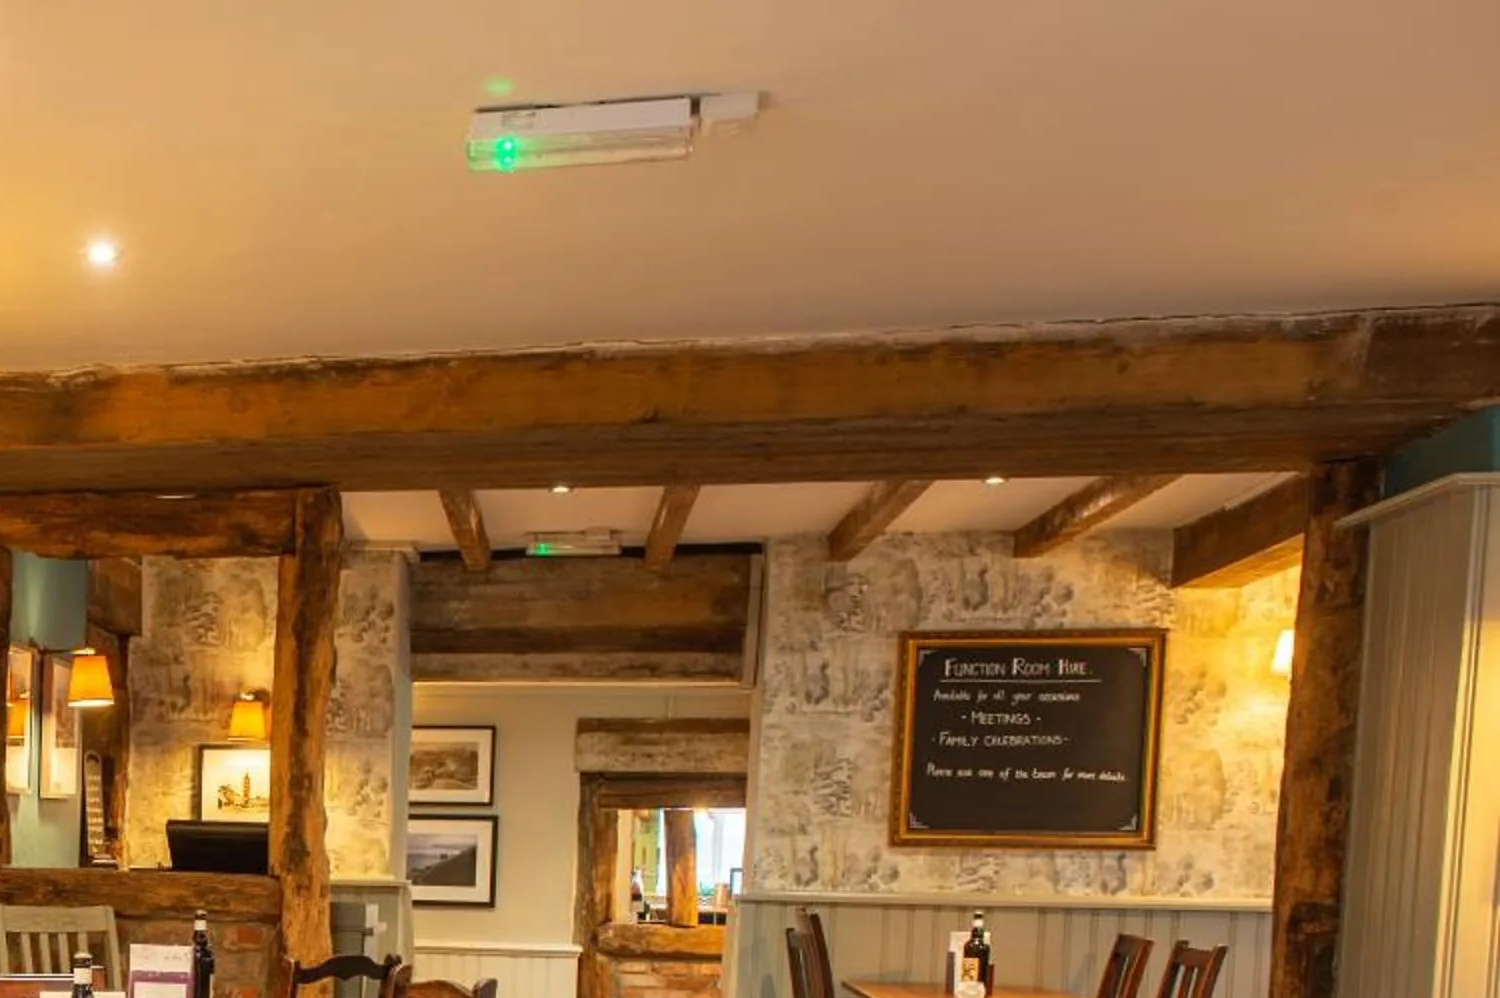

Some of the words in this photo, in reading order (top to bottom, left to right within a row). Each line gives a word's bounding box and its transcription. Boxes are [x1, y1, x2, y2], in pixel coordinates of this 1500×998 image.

[945, 657, 1006, 677] FUNCTION
[1012, 657, 1051, 676] ROOM
[971, 711, 1031, 726] MEETINGS
[939, 731, 979, 747] FAMILY
